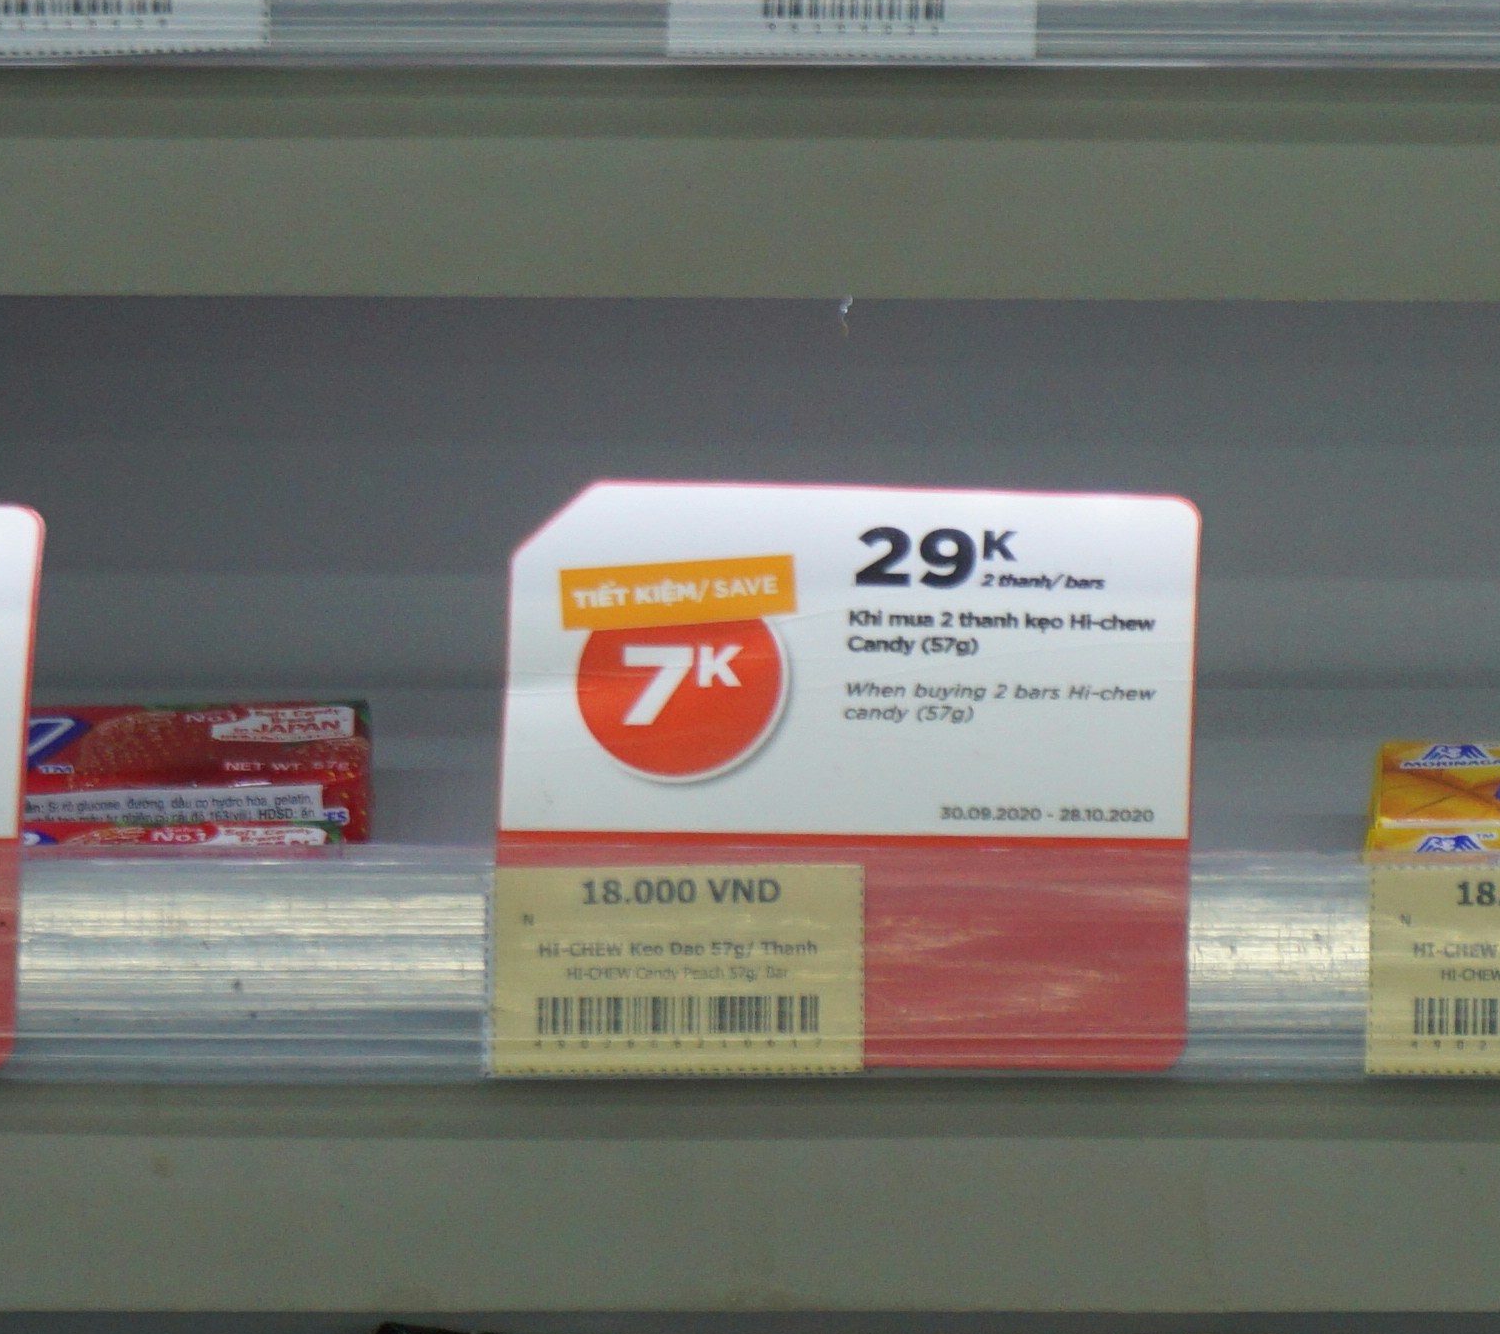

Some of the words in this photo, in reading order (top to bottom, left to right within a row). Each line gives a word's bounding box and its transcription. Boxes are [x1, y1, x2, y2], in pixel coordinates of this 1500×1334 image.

[714, 574, 779, 599] SAVE
[849, 611, 883, 627] Khi
[889, 613, 935, 627] mua
[941, 612, 955, 627] 2
[959, 612, 1018, 629] thanh
[1071, 614, 1156, 632] Hi-chew
[848, 636, 914, 656] Candy
[922, 636, 979, 656] (57g)
[847, 681, 905, 698] When
[915, 682, 987, 702] buying
[994, 685, 1007, 700] 2
[1014, 685, 1060, 700] bars
[1069, 685, 1157, 701] Hi-chew
[843, 706, 908, 724] candy
[940, 806, 1042, 822] 30.09.2020
[1059, 807, 1155, 823] 28.10.2020
[582, 879, 697, 905] 18.000
[708, 879, 781, 905] VND
